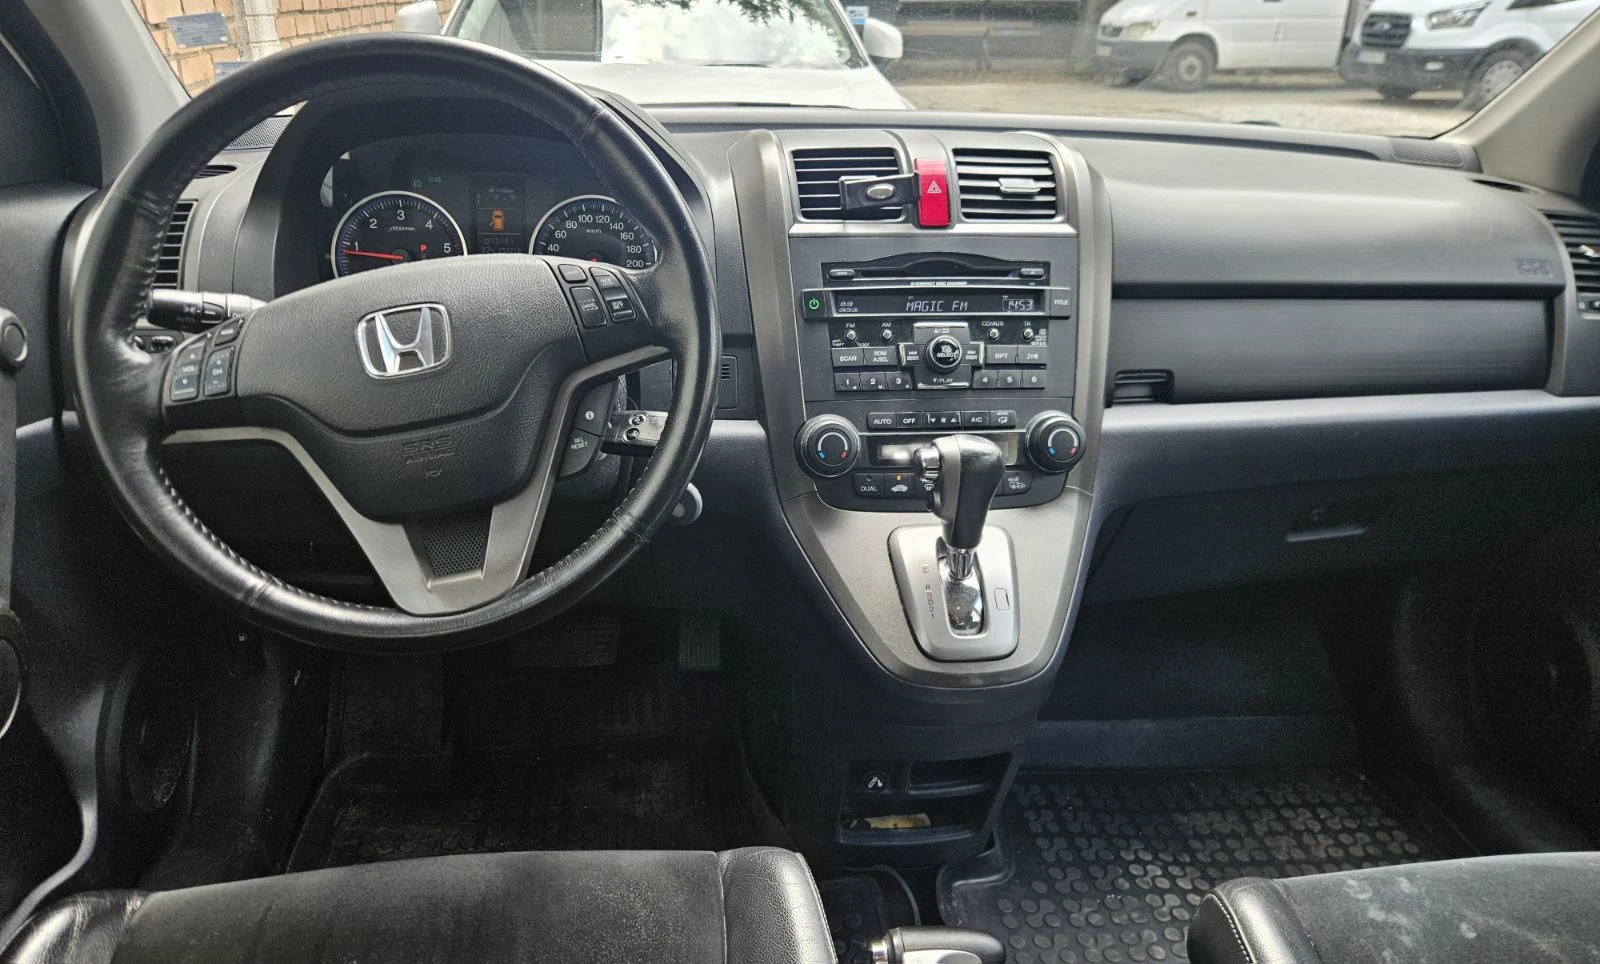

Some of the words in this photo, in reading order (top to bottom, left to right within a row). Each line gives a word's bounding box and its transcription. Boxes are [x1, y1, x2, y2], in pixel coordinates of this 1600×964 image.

[397, 210, 406, 220] 3
[578, 214, 593, 223] 100
[595, 215, 610, 223] 120
[369, 218, 378, 229] 2
[425, 219, 434, 230] 4
[565, 220, 578, 229] 80
[609, 222, 624, 231] 140
[554, 230, 567, 239] 60
[620, 231, 634, 240] 160
[354, 241, 359, 252] 1
[420, 243, 427, 252] P
[443, 243, 452, 253] 5
[547, 243, 560, 252] 40
[626, 245, 642, 254] 180
[905, 301, 944, 312] MAGIC
[952, 300, 968, 311] FM
[994, 352, 1009, 360] RPT
[1030, 376, 1038, 384] 6
